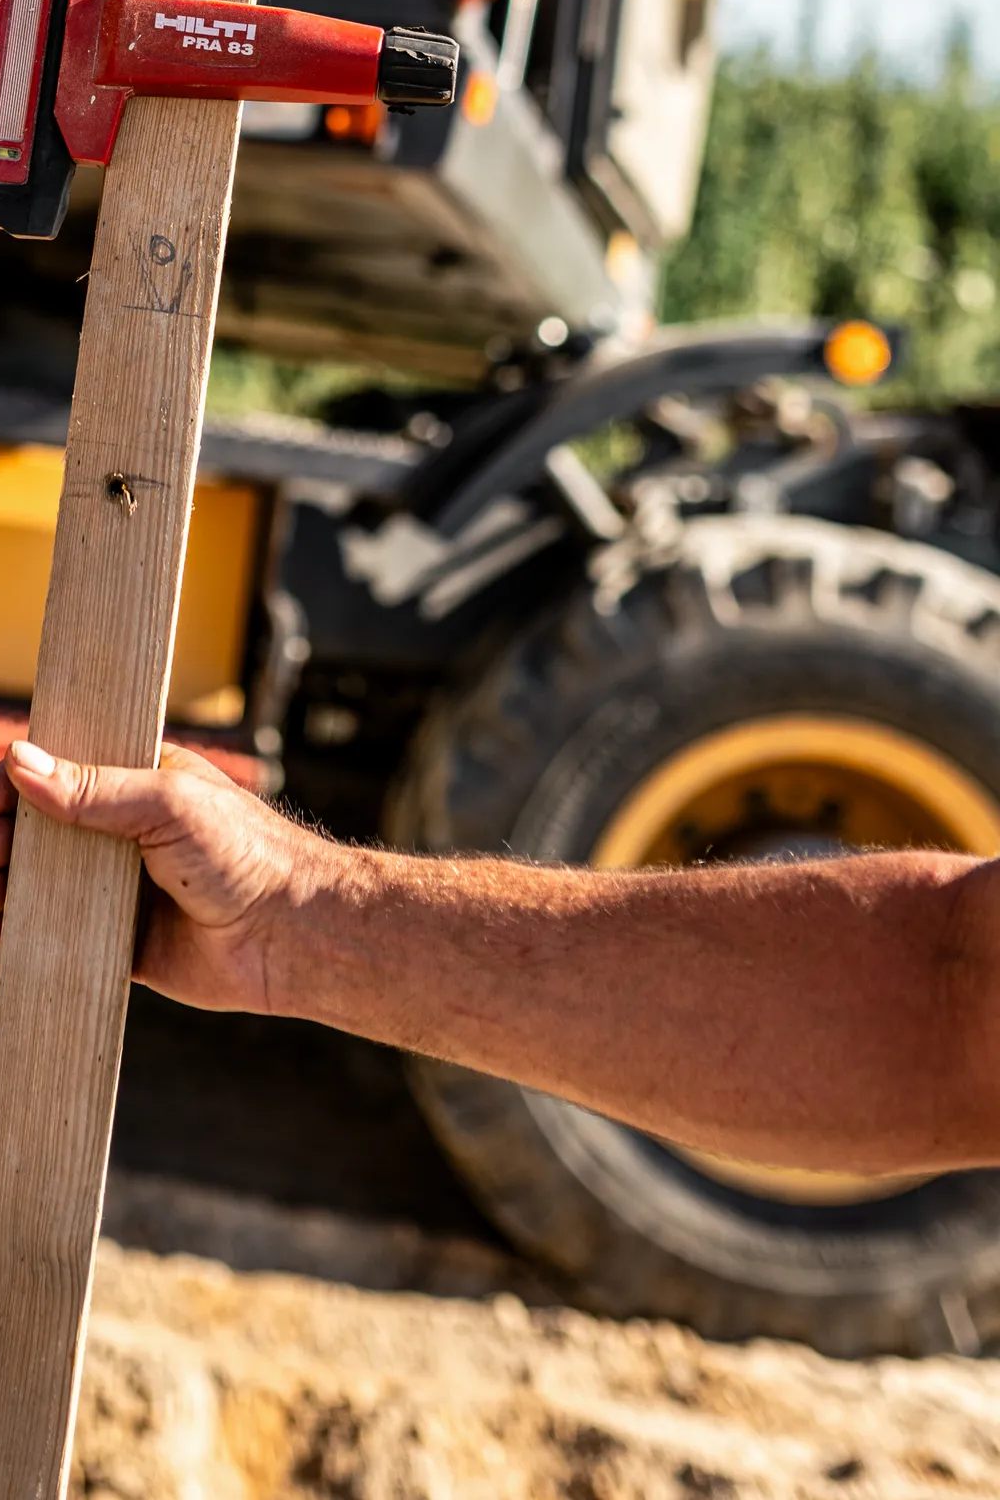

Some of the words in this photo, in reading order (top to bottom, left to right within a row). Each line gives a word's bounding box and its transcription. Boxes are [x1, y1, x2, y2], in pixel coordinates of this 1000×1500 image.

[154, 12, 257, 41] HILTI
[182, 35, 222, 52] PRA
[227, 41, 254, 56] 83
